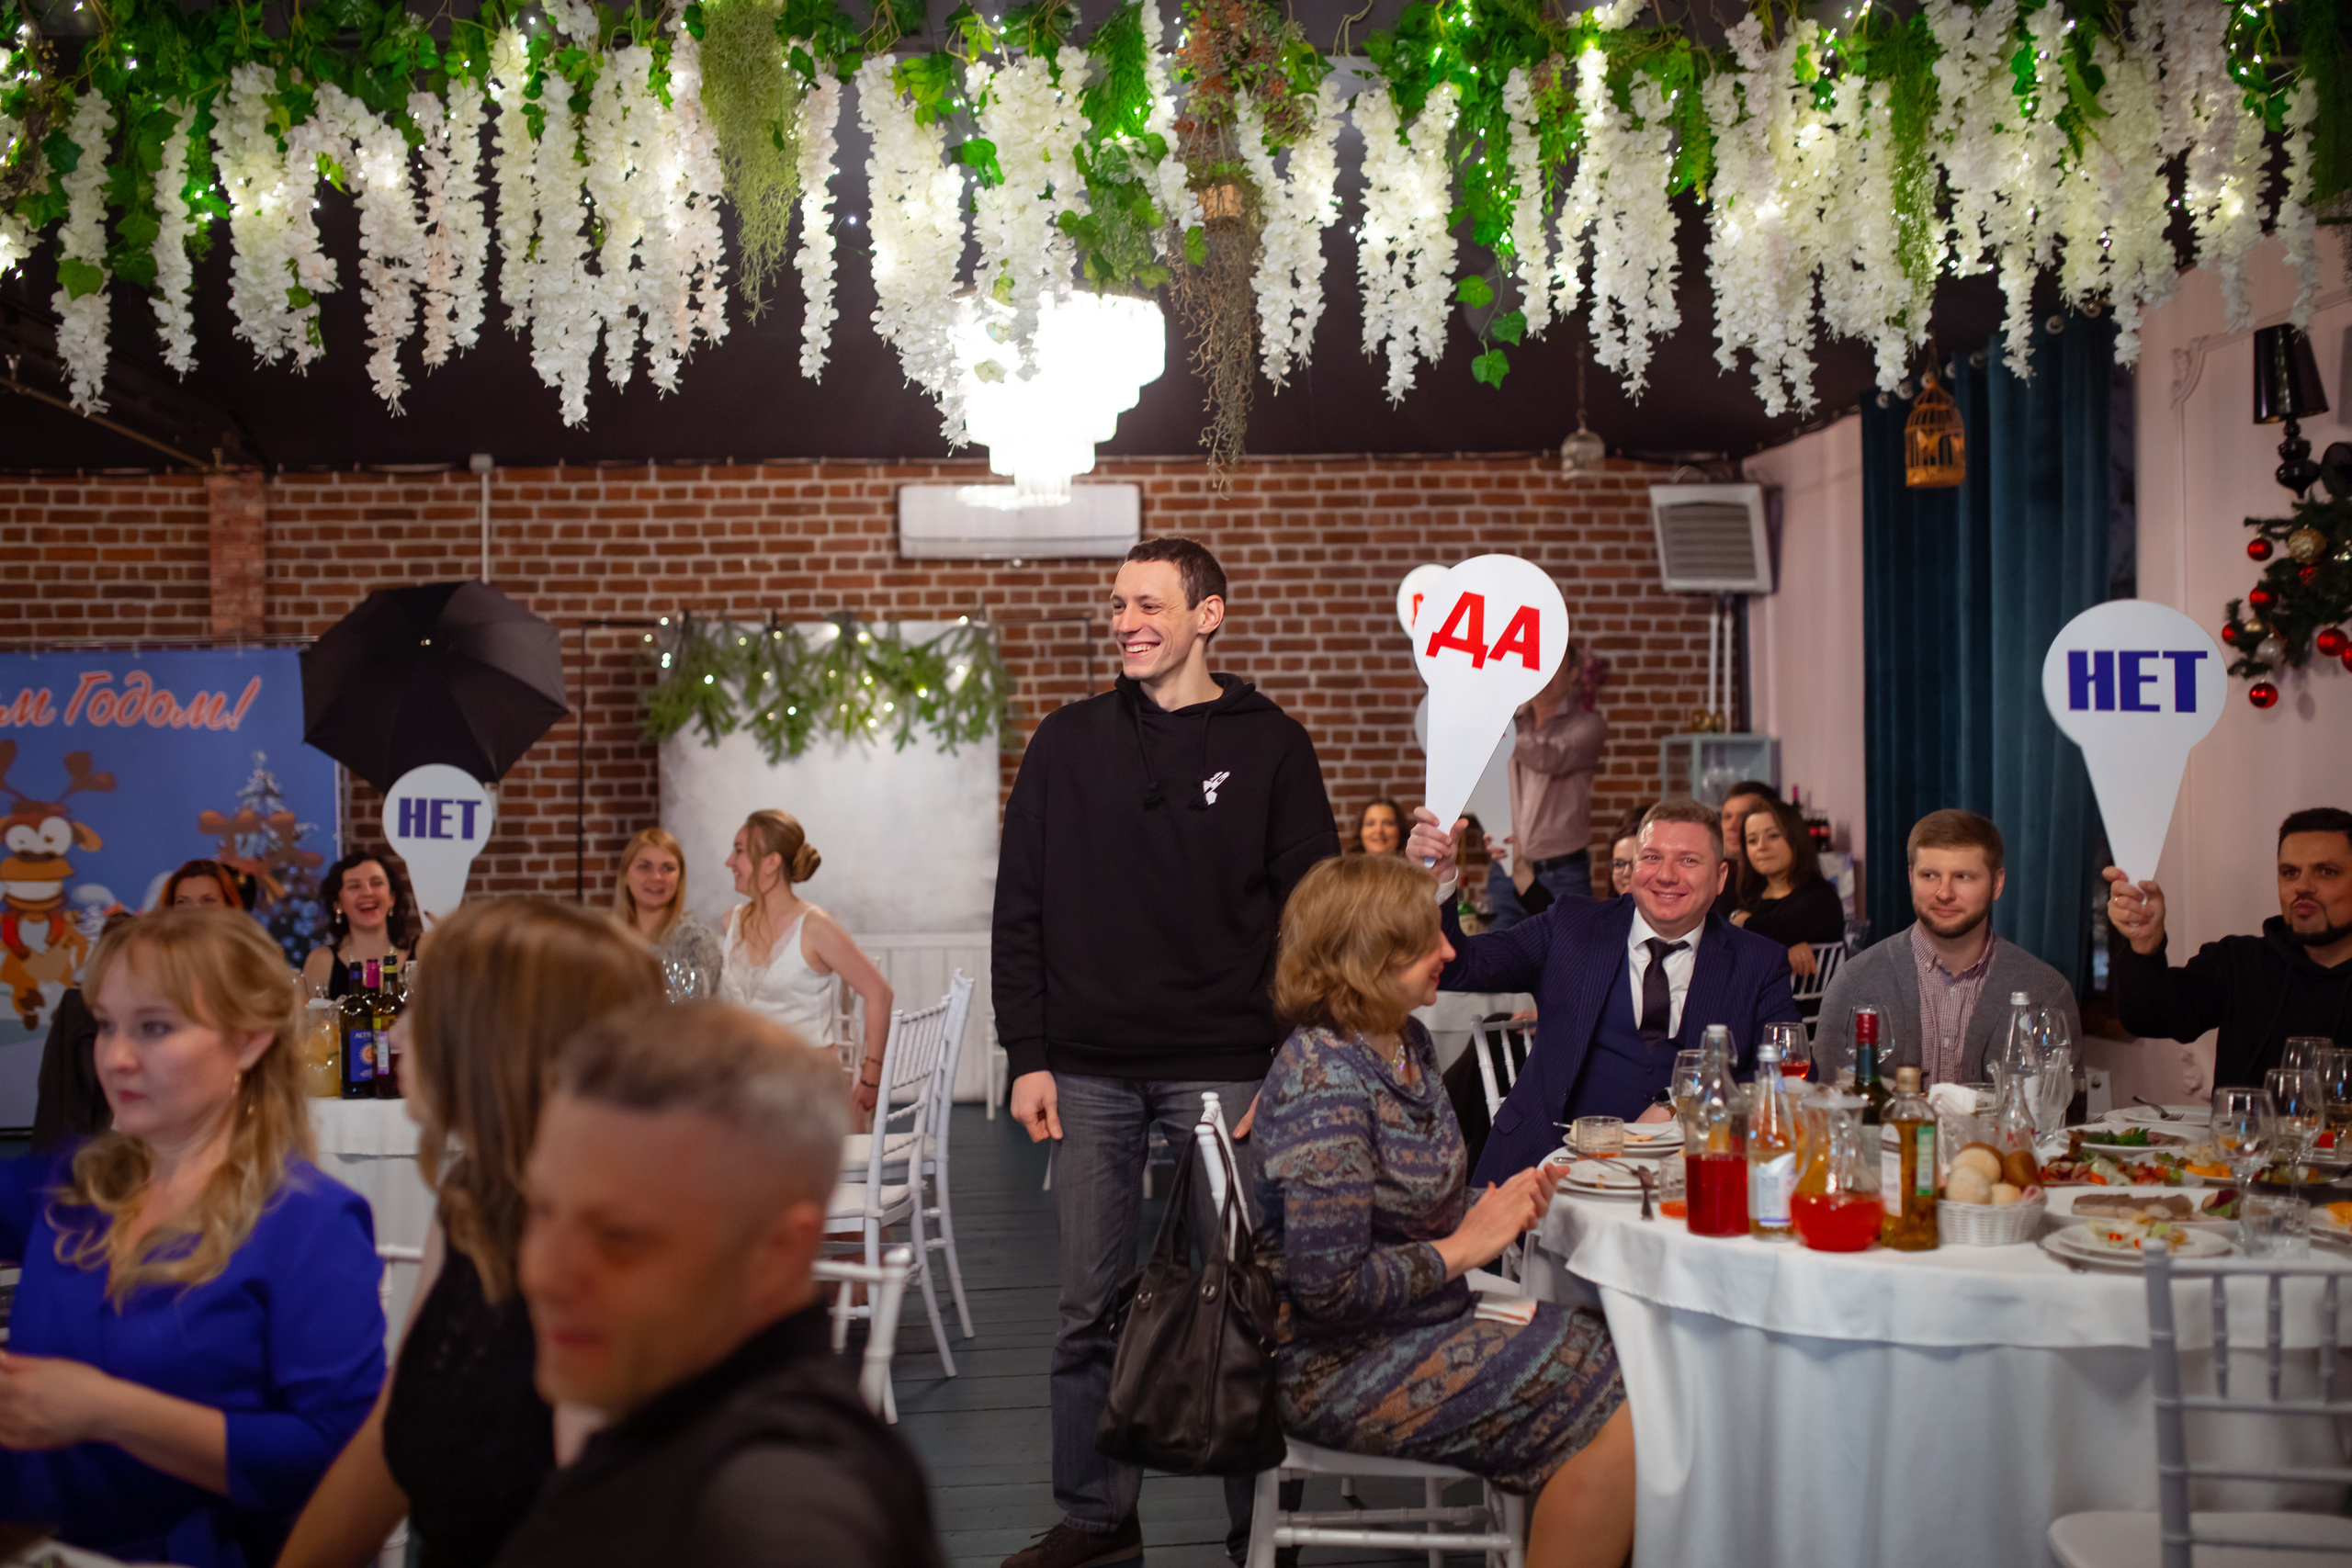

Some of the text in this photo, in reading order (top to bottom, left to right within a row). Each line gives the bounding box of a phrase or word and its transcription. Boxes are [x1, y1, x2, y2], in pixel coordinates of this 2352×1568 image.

[1425, 591, 1540, 671] ДА
[0, 670, 262, 731] м Годом!
[2067, 650, 2208, 713] НЕТ
[398, 797, 481, 840] НЕТ
